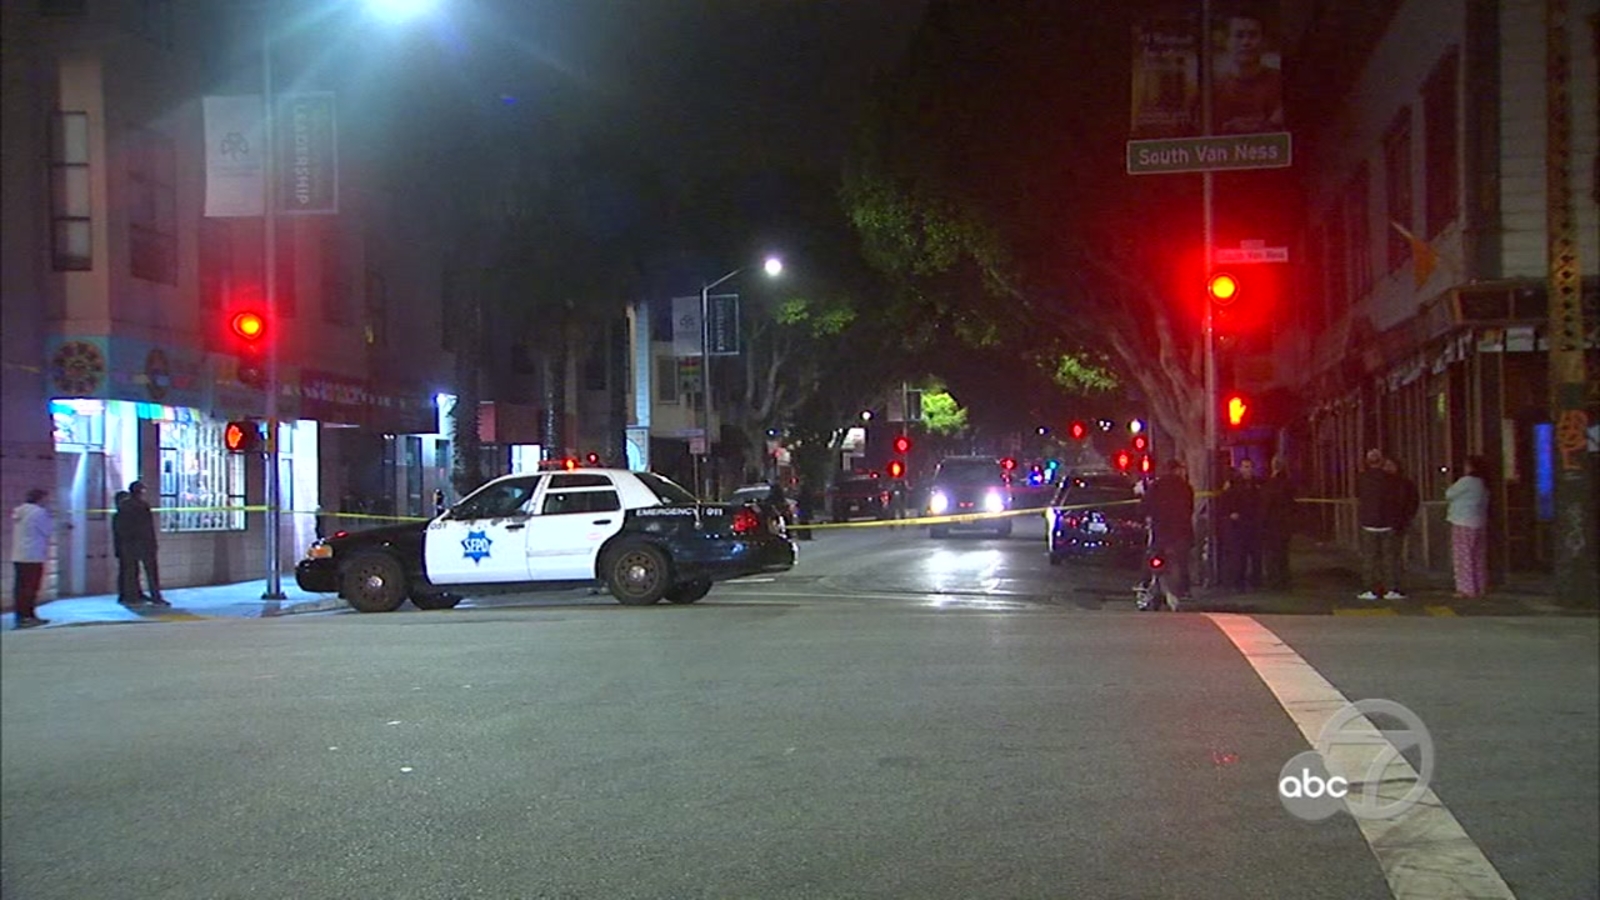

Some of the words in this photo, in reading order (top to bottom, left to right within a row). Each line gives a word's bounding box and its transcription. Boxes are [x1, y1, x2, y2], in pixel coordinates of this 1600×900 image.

[294, 103, 310, 205] LEADERSHIP
[1139, 148, 1189, 165] South
[1196, 146, 1227, 162] Van
[1235, 143, 1279, 160] Ness
[636, 507, 698, 516] EMERGENCY
[464, 538, 489, 553] SFPD
